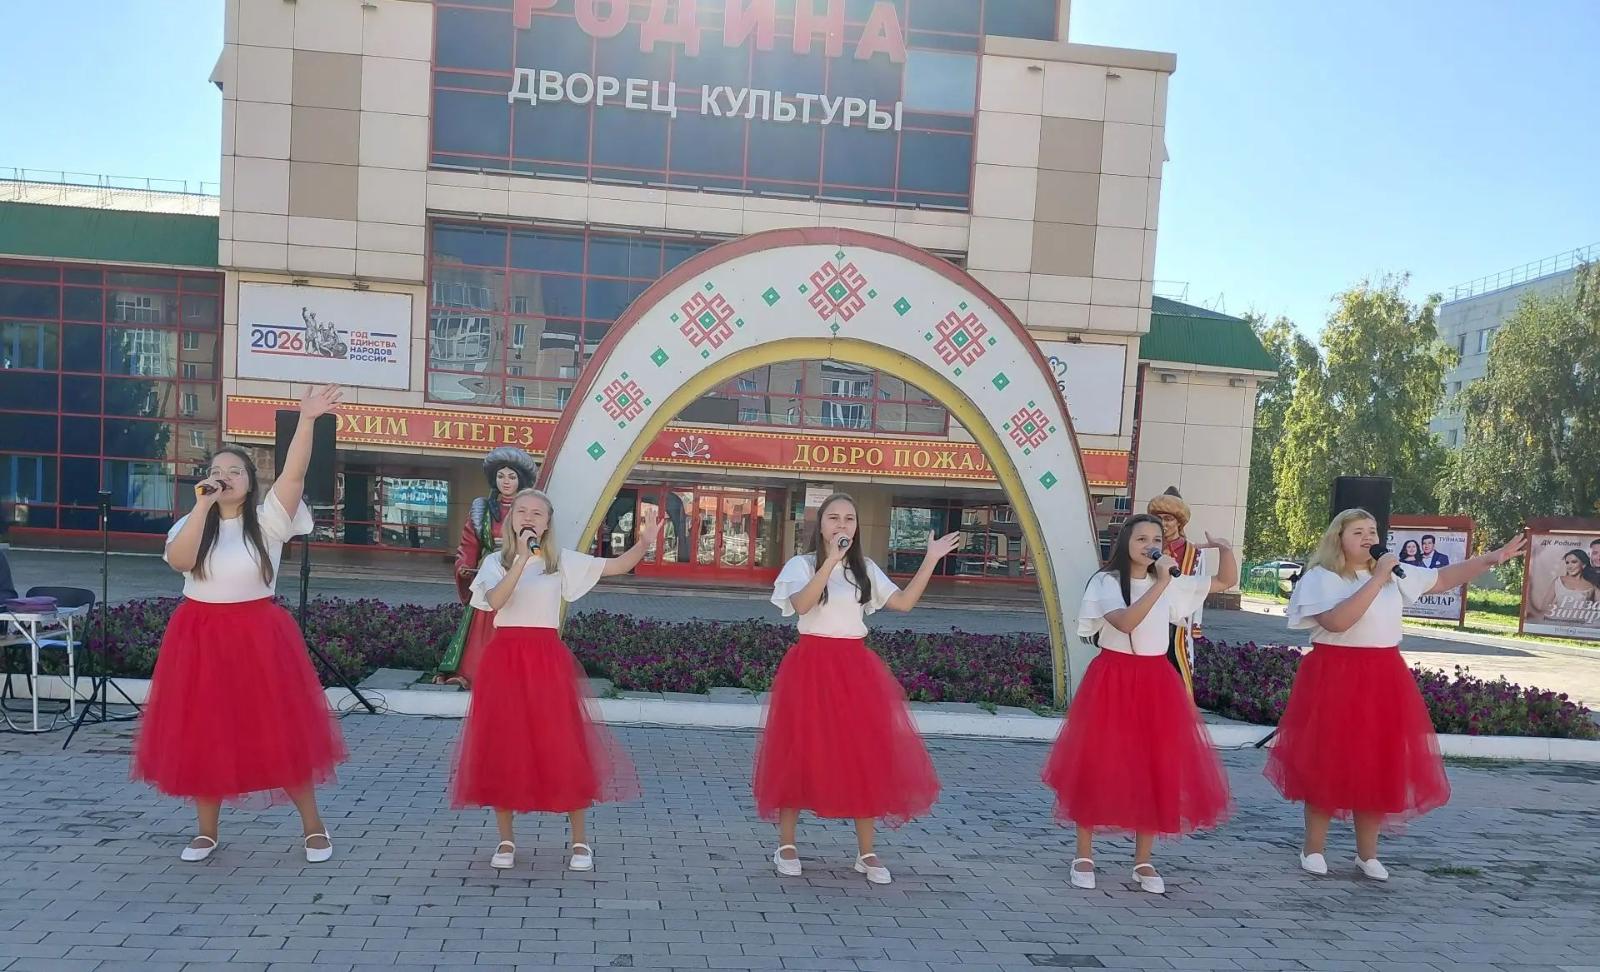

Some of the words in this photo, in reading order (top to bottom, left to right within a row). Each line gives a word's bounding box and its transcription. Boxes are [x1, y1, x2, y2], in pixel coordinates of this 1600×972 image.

[508, 67, 677, 118] ДВОРЕЦ
[700, 85, 902, 131] КУЛЬТУРЫ
[251, 329, 304, 351] 2026
[350, 331, 368, 339] ГОД
[350, 339, 397, 348] ЕДИНСТВА
[350, 347, 392, 355] НАРОДОВ
[350, 354, 387, 362] РОССИИ
[792, 444, 883, 466] ДОБРО
[1416, 595, 1455, 606] ОВЛАР
